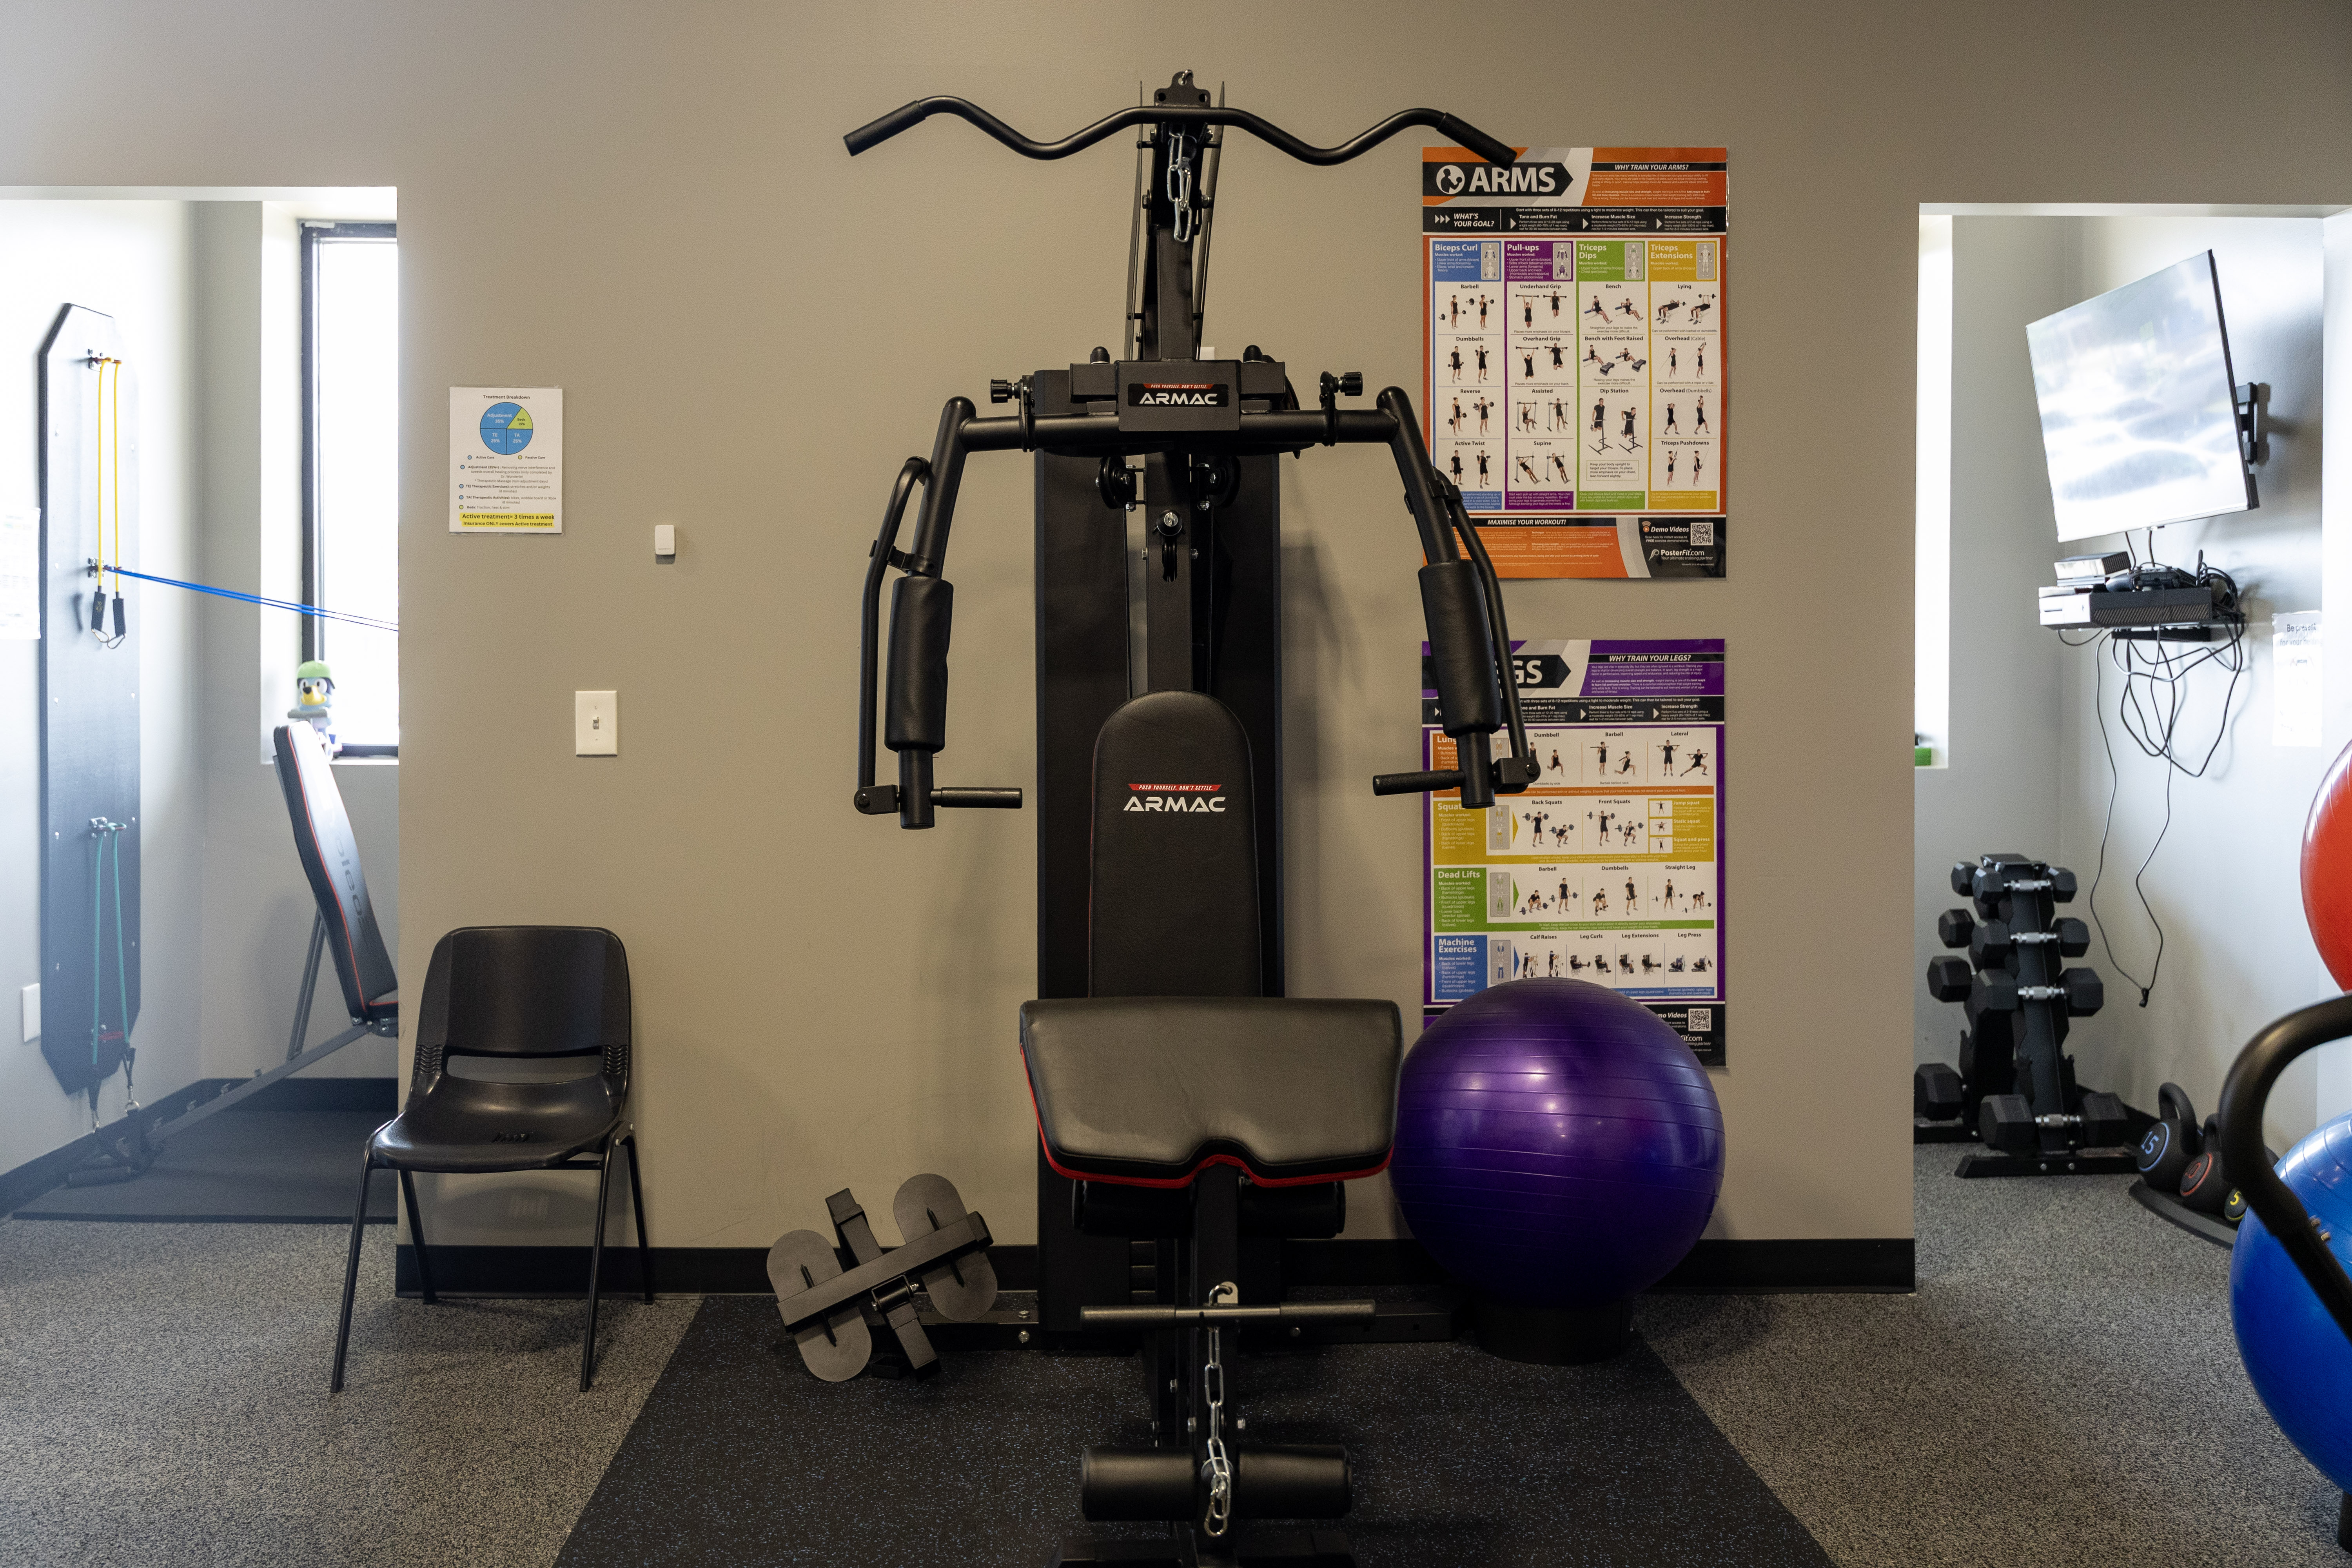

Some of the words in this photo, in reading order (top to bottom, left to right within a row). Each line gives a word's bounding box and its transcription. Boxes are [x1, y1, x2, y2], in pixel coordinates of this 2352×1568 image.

[1469, 167, 1555, 192] ARMS
[1139, 393, 1218, 404] ARMAC
[1513, 660, 1542, 684] GS
[1437, 735, 1456, 744] Lung
[1123, 797, 1226, 812] ARMAC
[1437, 803, 1465, 812] Squat
[2141, 1131, 2159, 1154] 15
[2230, 1191, 2241, 1205] 5
